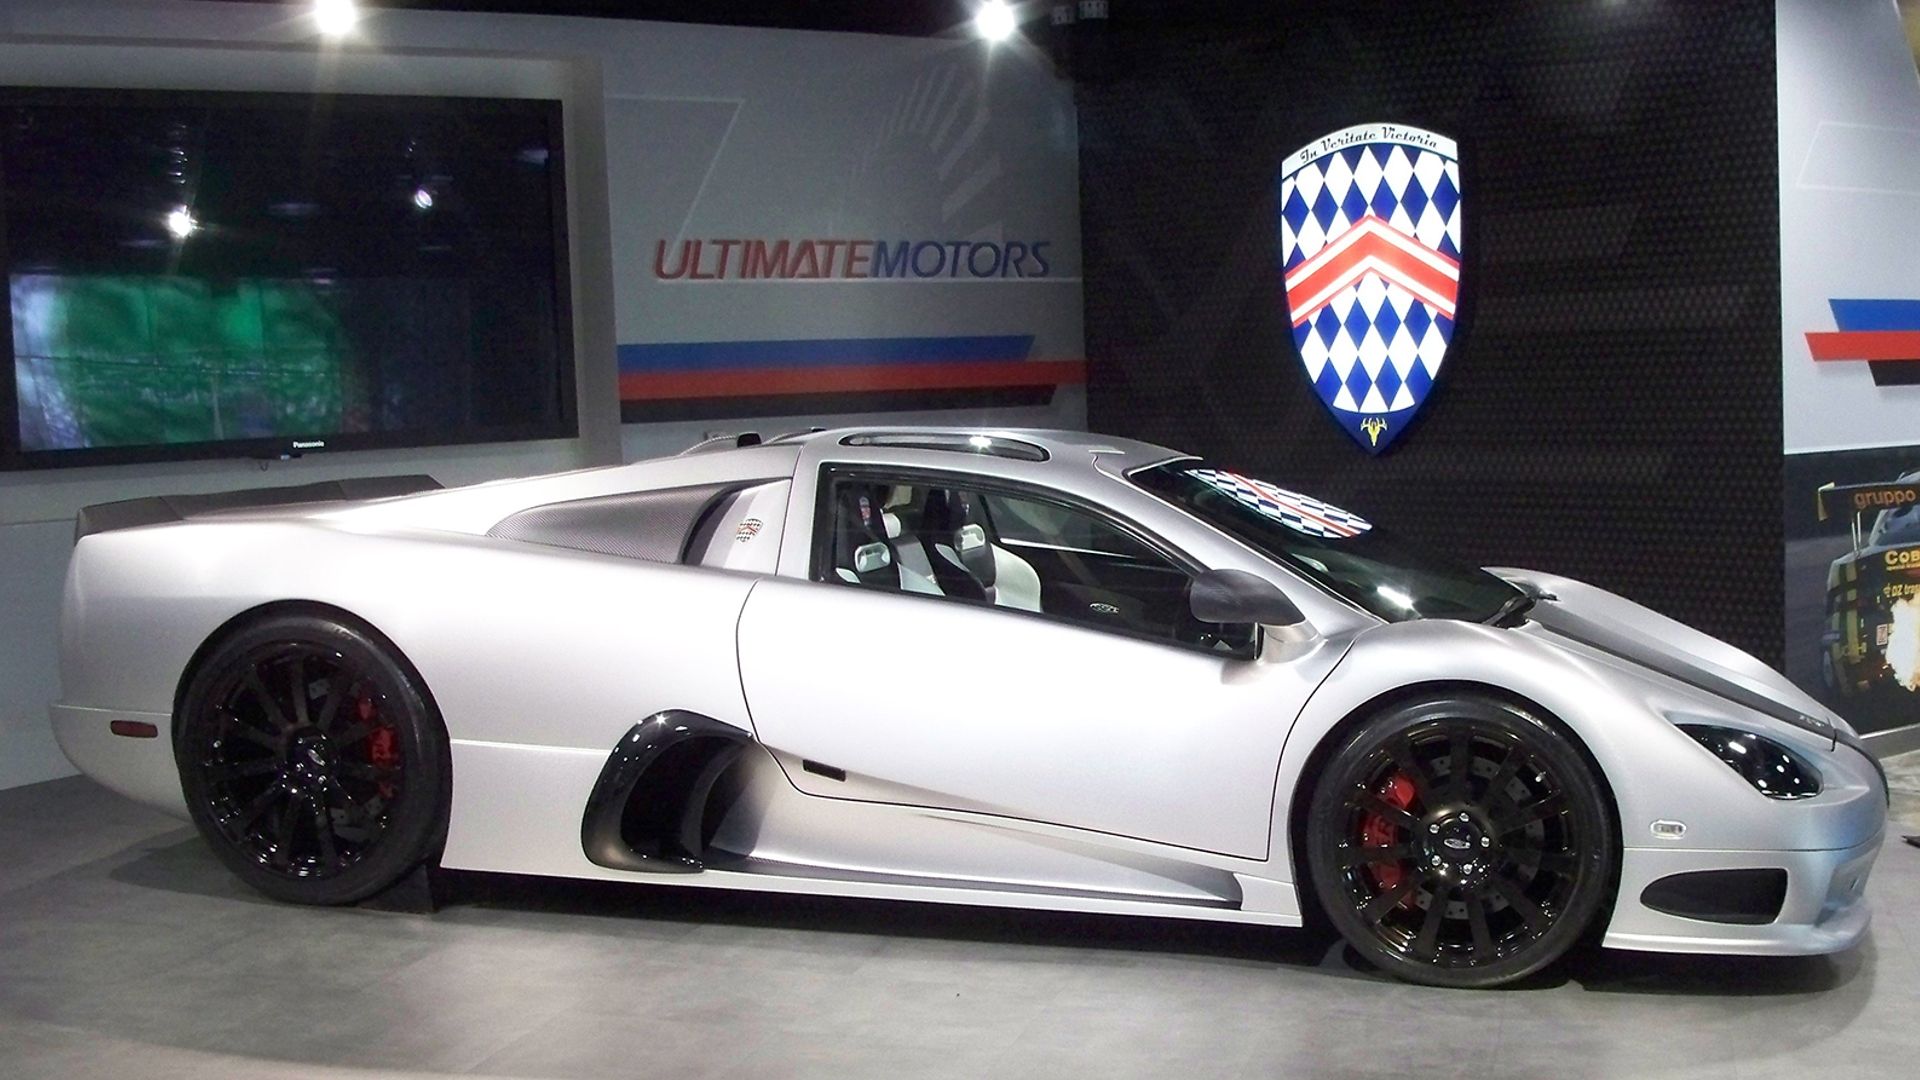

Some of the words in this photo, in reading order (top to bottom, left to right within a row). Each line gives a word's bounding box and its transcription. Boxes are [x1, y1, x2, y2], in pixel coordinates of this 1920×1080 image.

[1300, 148, 1317, 163] In
[1321, 131, 1376, 151] Veritate
[1381, 126, 1438, 148] Victoria
[292, 440, 325, 449] Panasonic
[1854, 489, 1916, 510] gruppo
